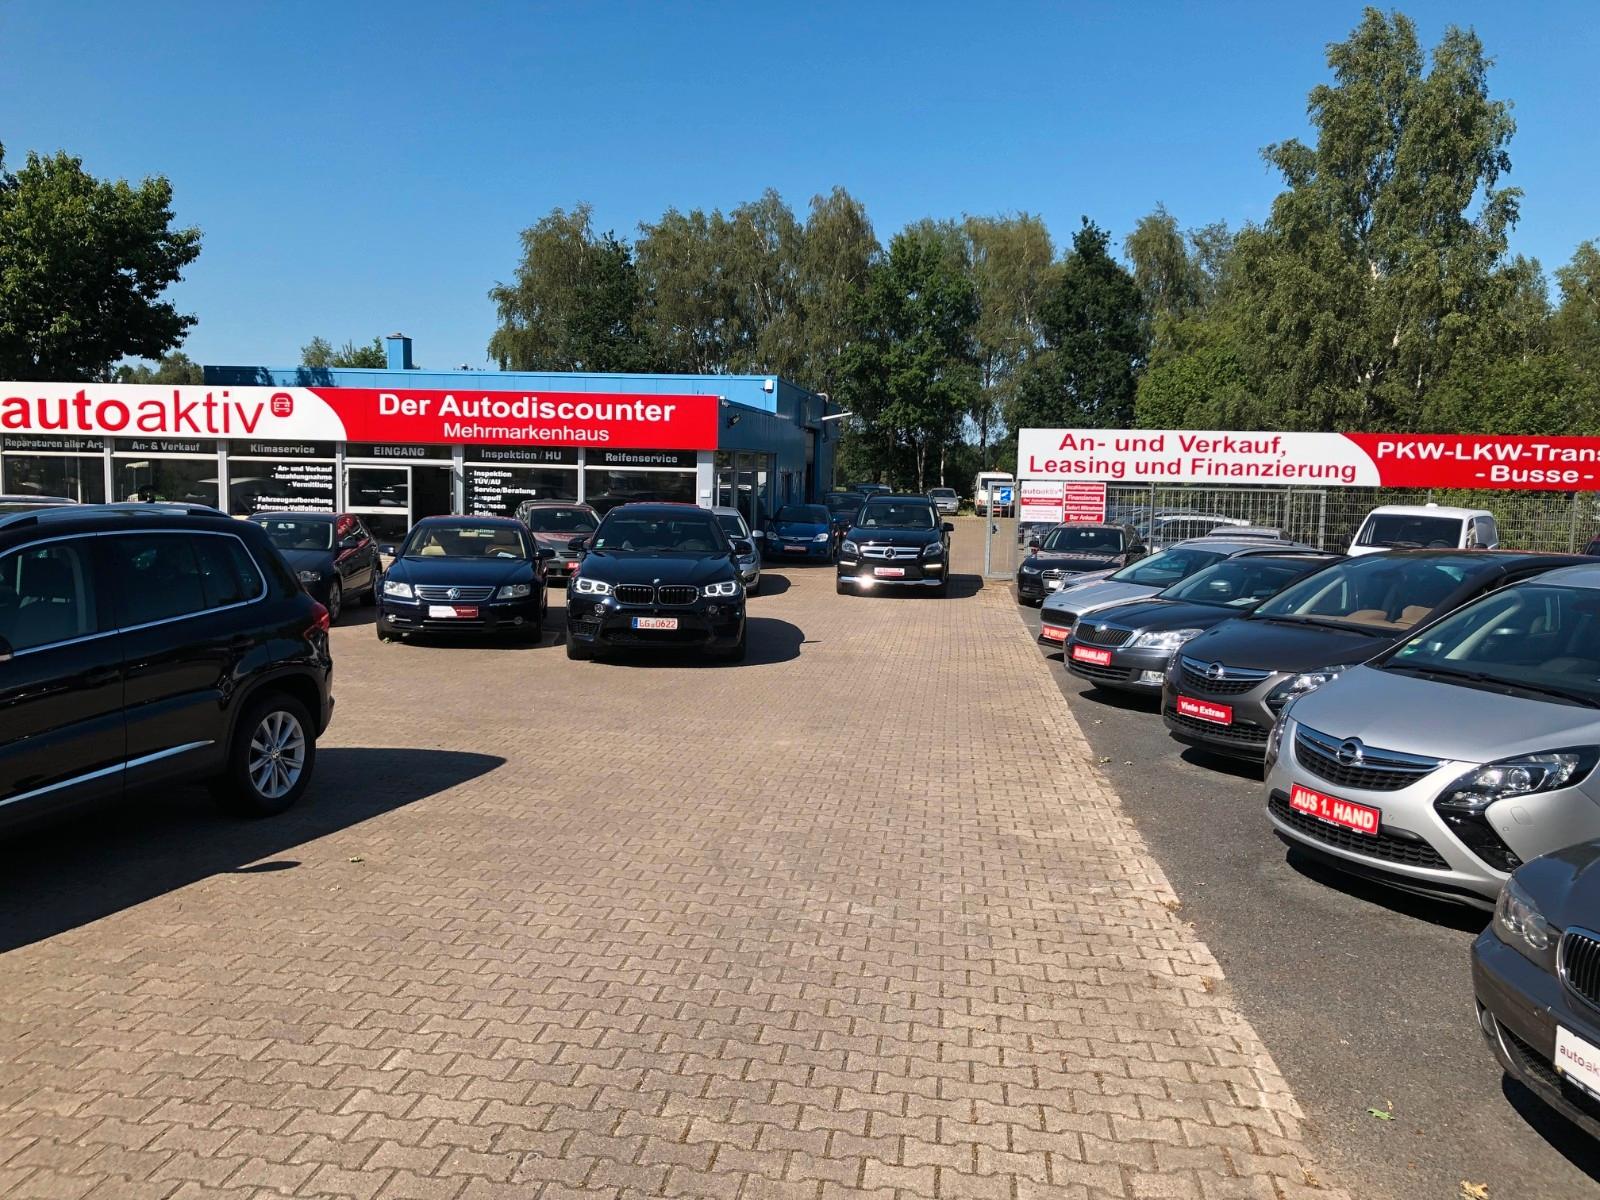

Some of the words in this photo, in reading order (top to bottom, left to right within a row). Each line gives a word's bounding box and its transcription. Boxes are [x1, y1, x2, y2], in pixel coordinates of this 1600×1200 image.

[1, 388, 265, 434] autoaktiv
[378, 392, 431, 417] Der
[438, 395, 677, 422] Autodiscounter
[443, 421, 610, 442] Mehrmarkenhaus
[4, 438, 63, 449] Reparaturen
[64, 439, 86, 449] aller
[87, 439, 104, 449] Art
[132, 441, 149, 450] An-
[150, 441, 158, 450] &
[161, 442, 201, 452] Verkauf
[250, 444, 315, 455] Klimaservice
[1059, 433, 1106, 452] An-
[1115, 434, 1165, 452] und
[1179, 435, 1287, 458] Verkauf,
[373, 446, 425, 457] EINGANG
[481, 448, 537, 462] Inspektion
[545, 450, 562, 461] HU
[605, 452, 678, 464] Reifenservice
[305, 465, 333, 473] Verkauf
[473, 470, 512, 478] Inspektion
[1029, 455, 1126, 479] Leasing
[1135, 457, 1182, 476] und
[1191, 458, 1357, 483] Finanzierung
[656, 618, 678, 629] 0622
[1181, 702, 1198, 713] Viele
[1199, 705, 1226, 719] Extras
[1294, 790, 1318, 812] AUS
[1321, 798, 1331, 816] 1.
[1333, 803, 1374, 828] HAND
